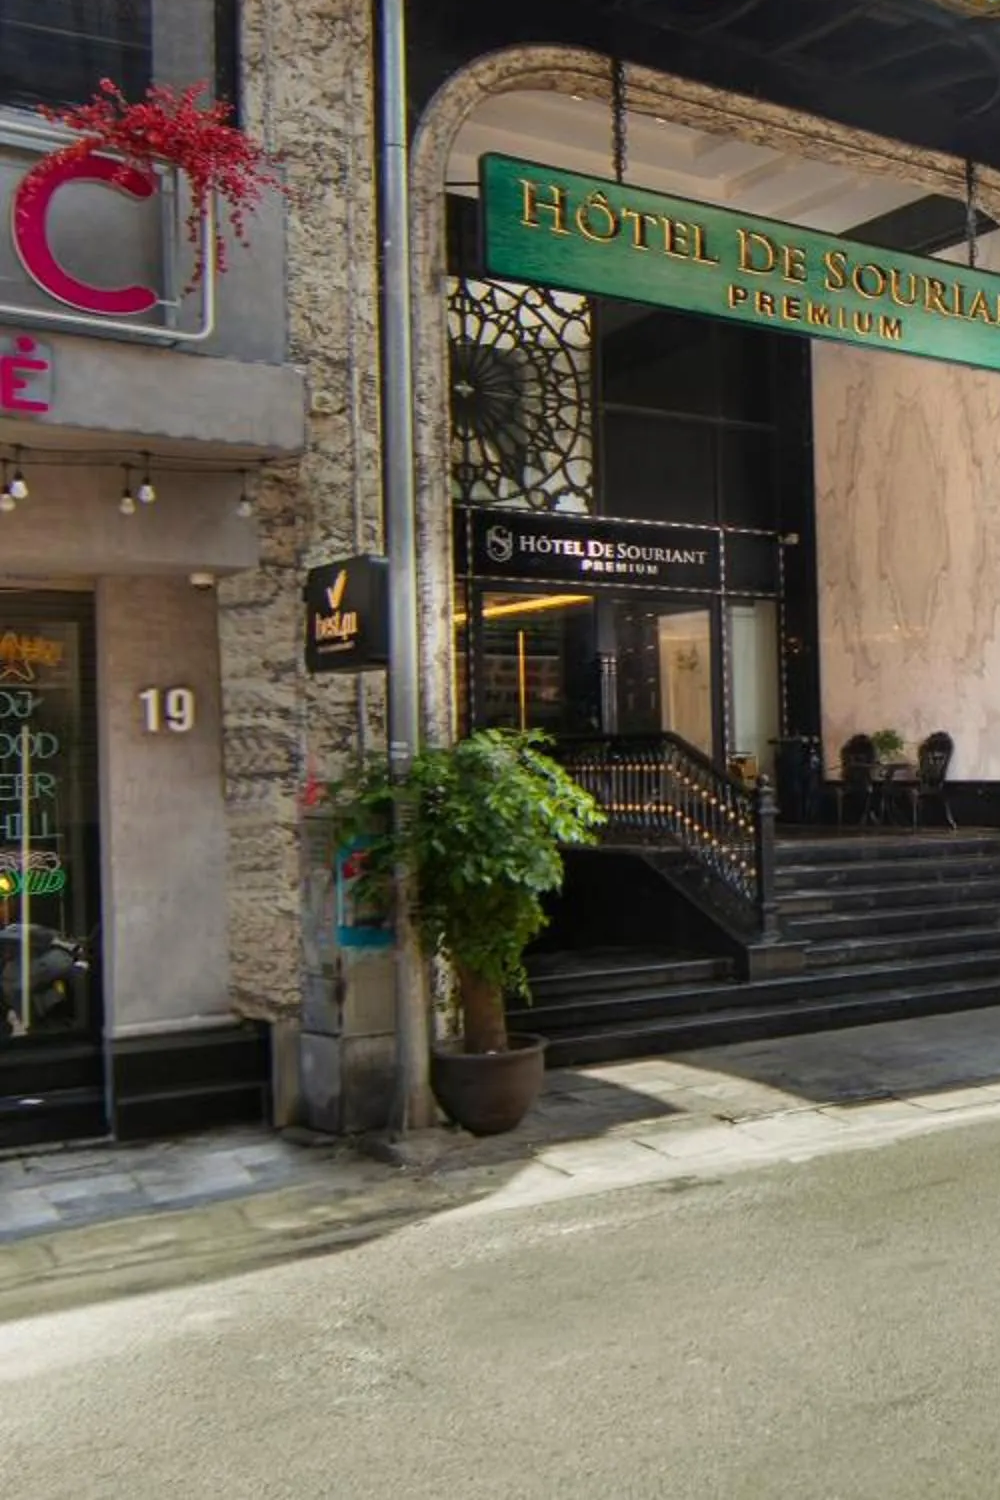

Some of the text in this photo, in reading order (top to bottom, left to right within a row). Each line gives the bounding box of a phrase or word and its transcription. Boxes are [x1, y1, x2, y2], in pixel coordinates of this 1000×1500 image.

[519, 178, 720, 267] HÔTEL
[728, 283, 903, 342] PREMIUM
[580, 558, 660, 576] PREMIUM
[617, 543, 709, 565] SOURIANT
[136, 687, 196, 734] 19
